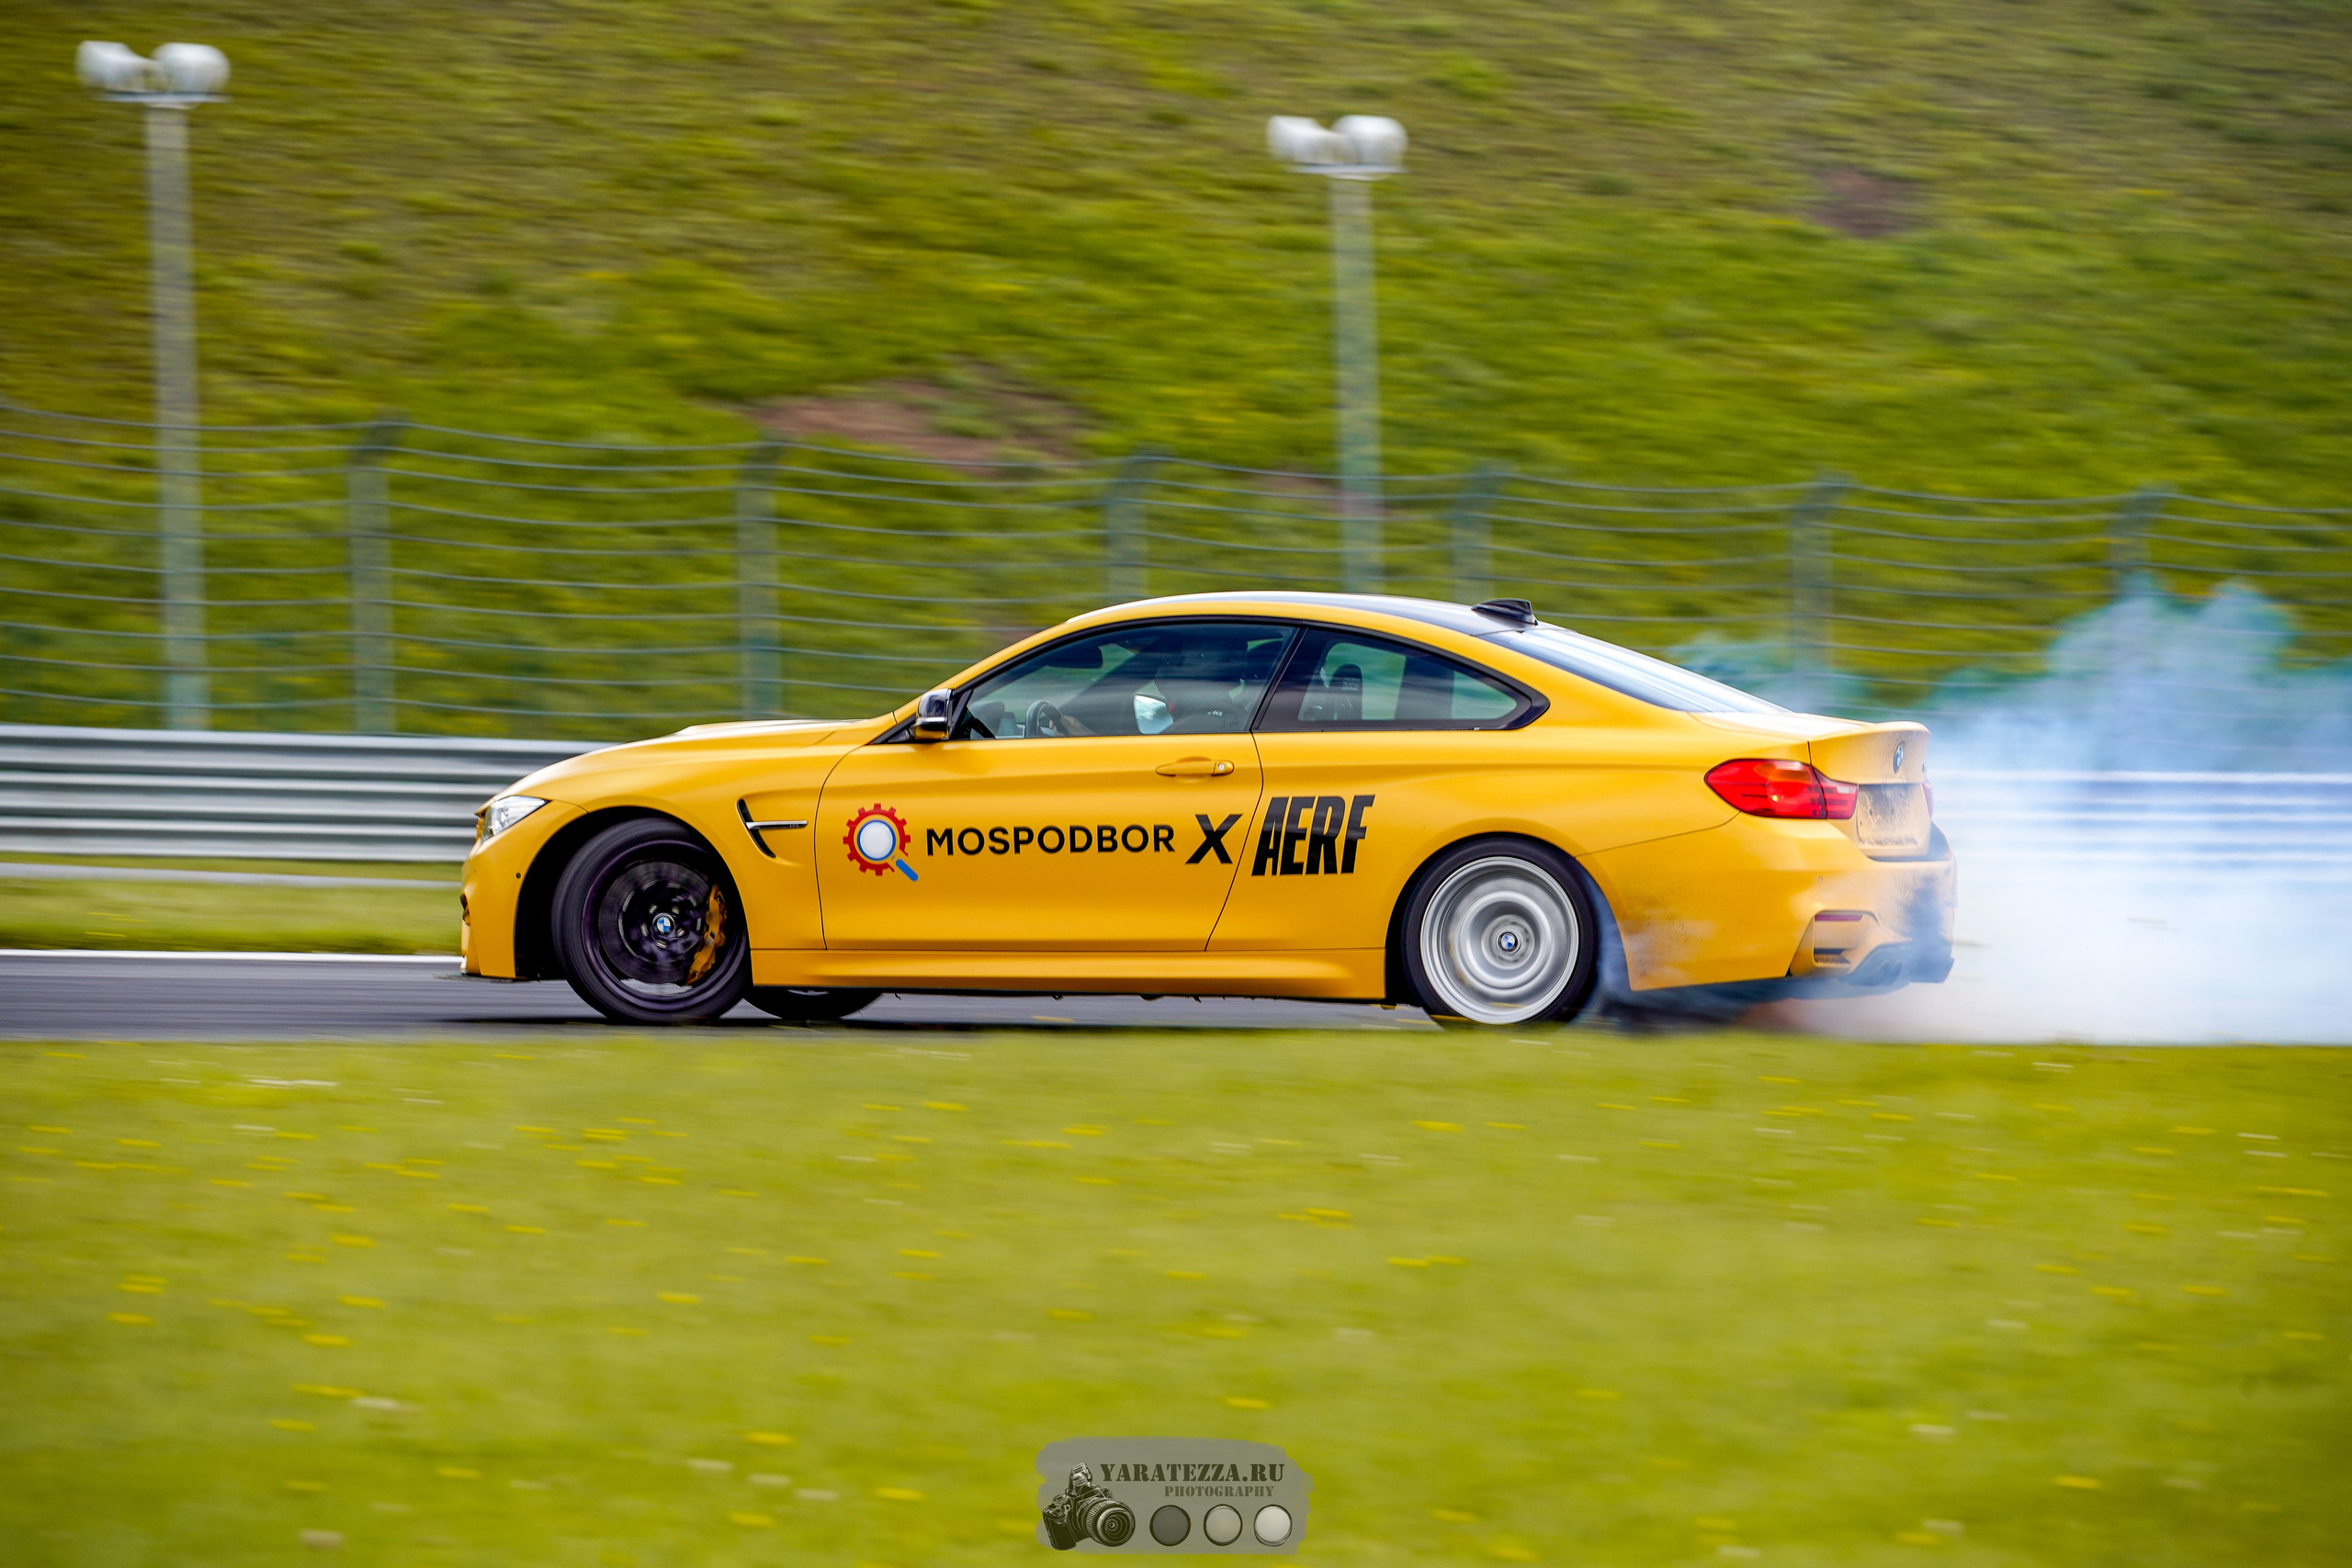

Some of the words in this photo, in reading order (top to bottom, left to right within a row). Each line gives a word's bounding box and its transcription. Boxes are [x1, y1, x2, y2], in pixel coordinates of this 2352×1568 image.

[926, 824, 1176, 857] MOSPODBOR
[1185, 814, 1243, 865] X
[1251, 795, 1376, 877] AERF
